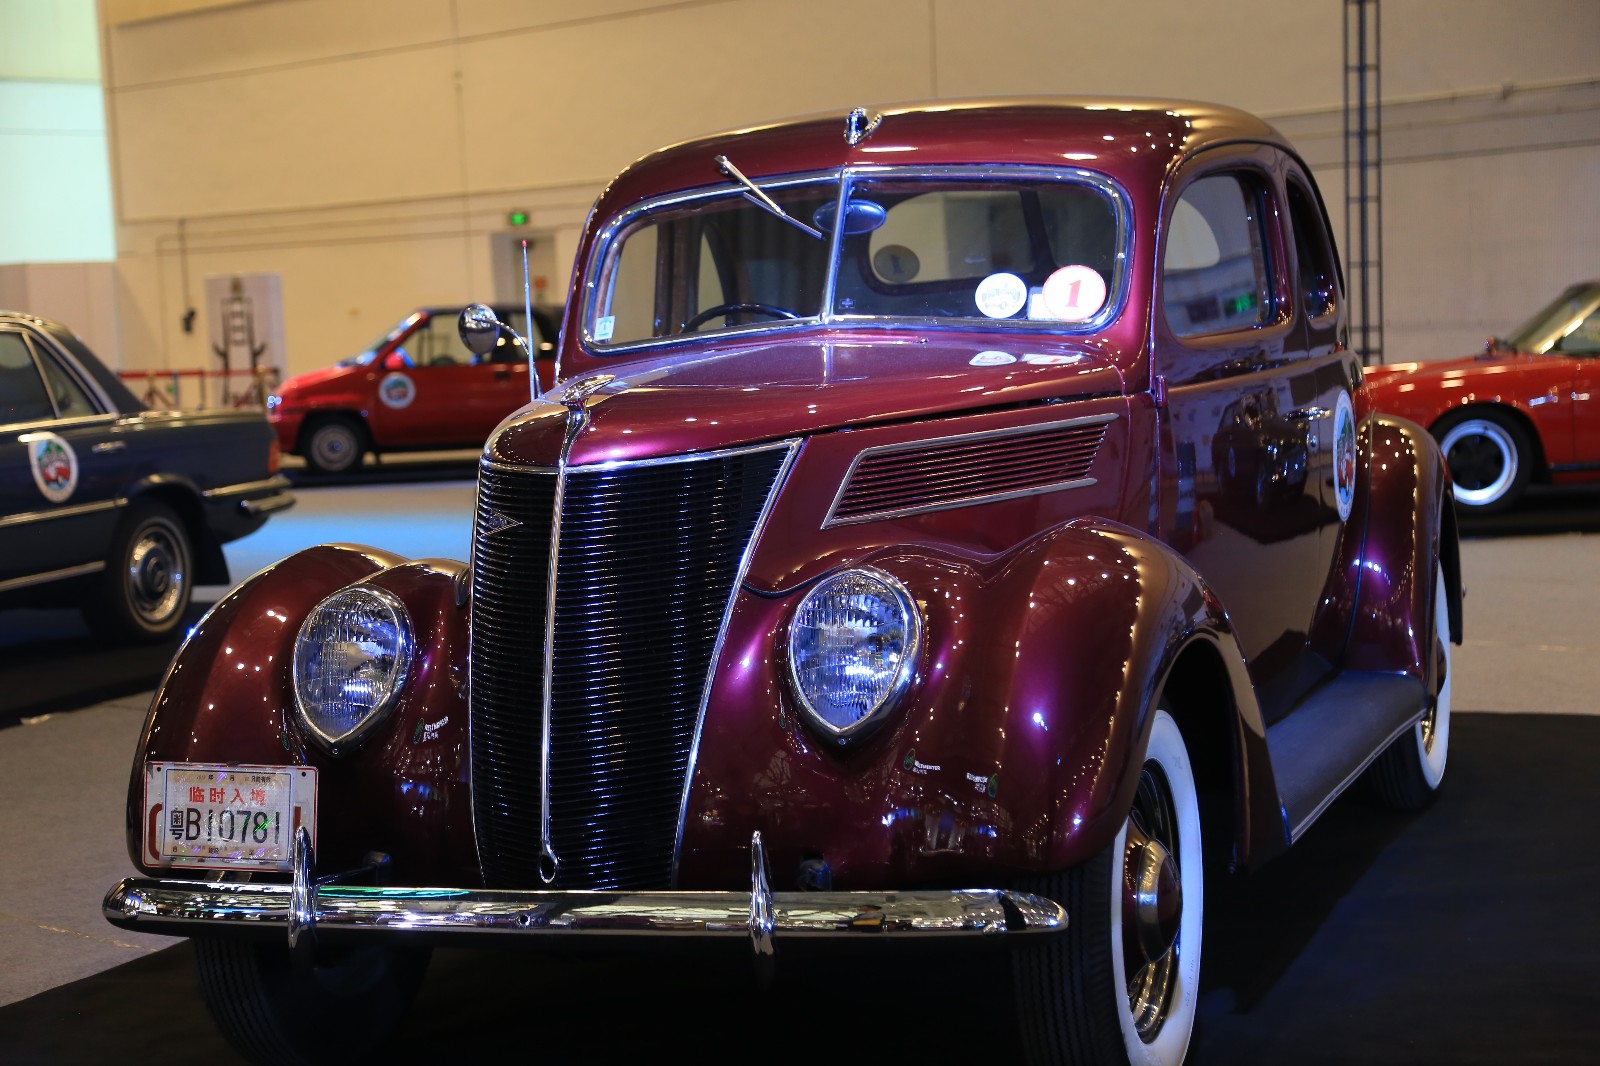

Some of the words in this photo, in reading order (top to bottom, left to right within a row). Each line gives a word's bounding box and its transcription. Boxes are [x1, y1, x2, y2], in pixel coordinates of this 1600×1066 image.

[1065, 279, 1082, 308] 1
[189, 787, 267, 806] 临时入境
[169, 807, 280, 845] 粤B10781
